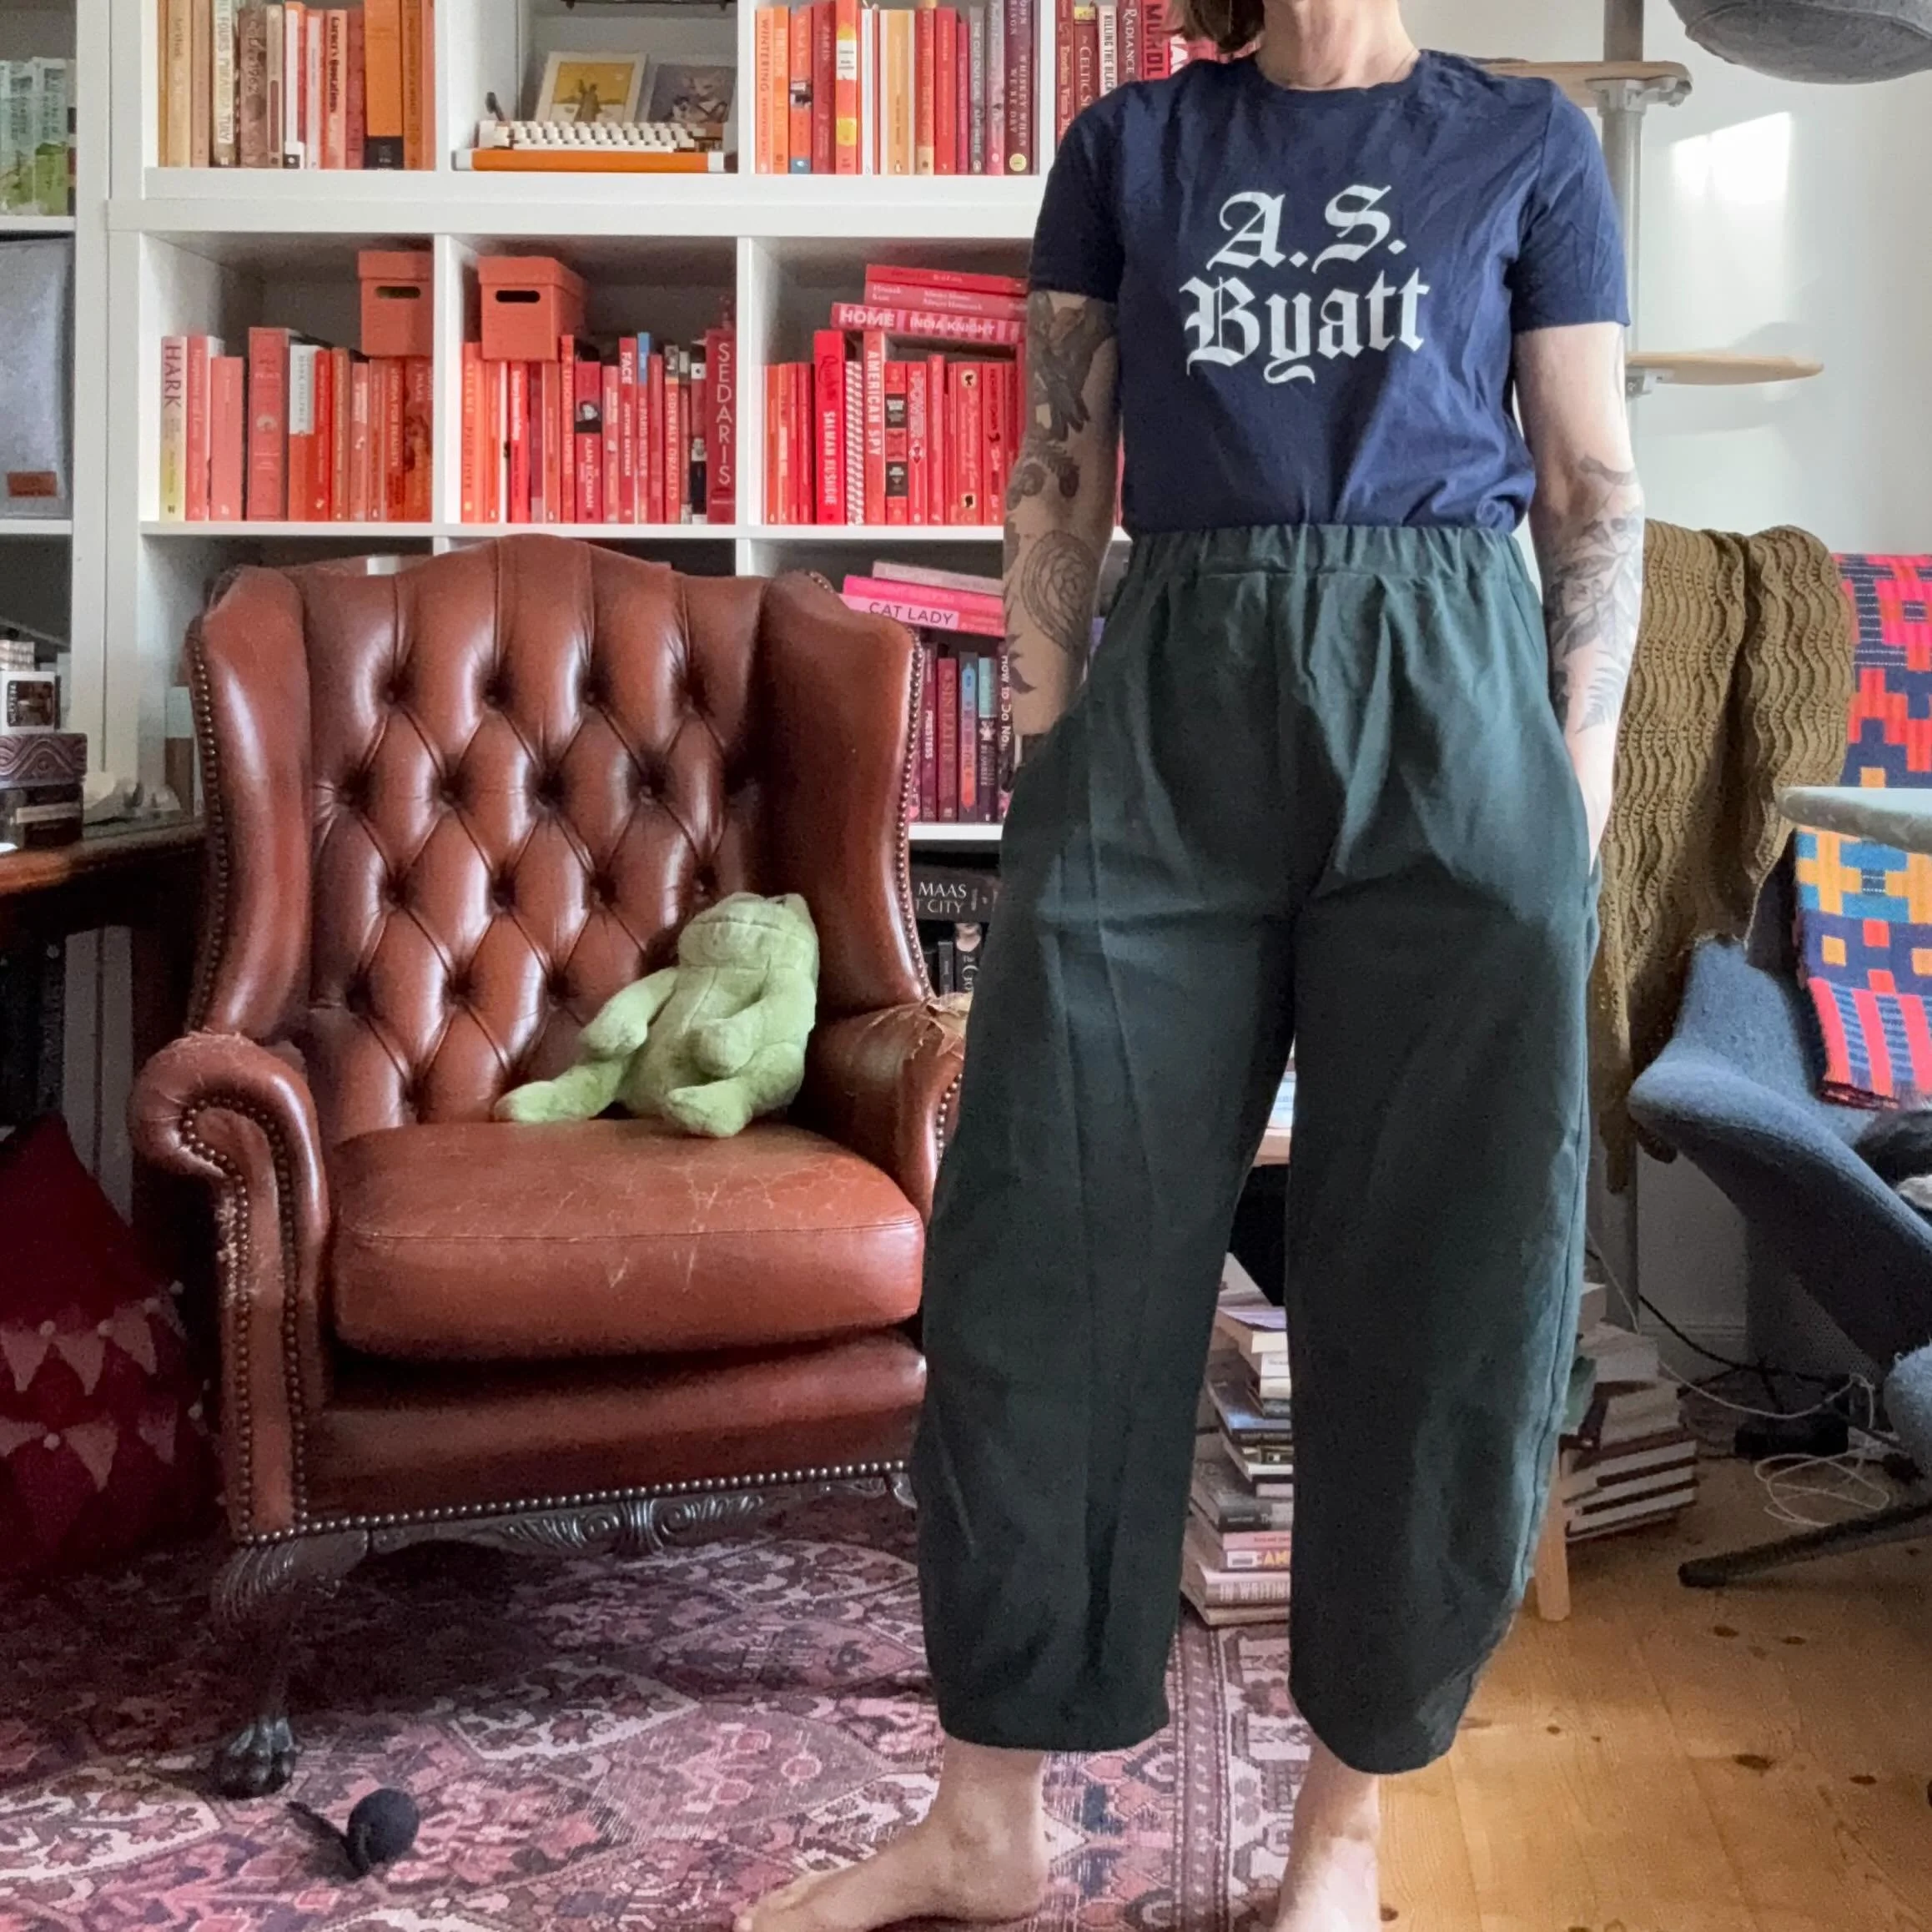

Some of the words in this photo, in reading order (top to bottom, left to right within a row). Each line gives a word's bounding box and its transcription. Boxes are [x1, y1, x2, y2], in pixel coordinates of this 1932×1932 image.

[973, 22, 982, 38] THE
[973, 40, 981, 58] CUT
[1104, 15, 1115, 47] KILLING
[1124, 8, 1138, 74] RADIANCE
[1145, 3, 1164, 76] MURDL
[760, 18, 771, 92] WINTERING
[973, 61, 981, 78] OUT
[1079, 46, 1092, 92] CELTIC
[1104, 49, 1114, 63] THE
[1019, 54, 1028, 108] WHISKEY
[1206, 191, 1308, 271] A.
[1311, 184, 1407, 274] S.
[839, 309, 895, 329] HOME
[909, 316, 945, 330] INDIA
[946, 320, 995, 336] KNIGHT
[1179, 267, 1431, 385] Byatt
[164, 345, 182, 409] HARK
[621, 351, 633, 385] FACE
[867, 350, 883, 423] AMERICAN
[667, 391, 677, 444] SIDEWALK
[715, 342, 733, 486] SEDARIS
[823, 410, 837, 456] SALMAN
[585, 437, 594, 462] ALAN
[868, 429, 882, 456] SPY
[868, 601, 902, 618] CAT
[908, 606, 954, 626] LADY
[918, 881, 968, 898] MAAS
[927, 898, 965, 914] CITY
